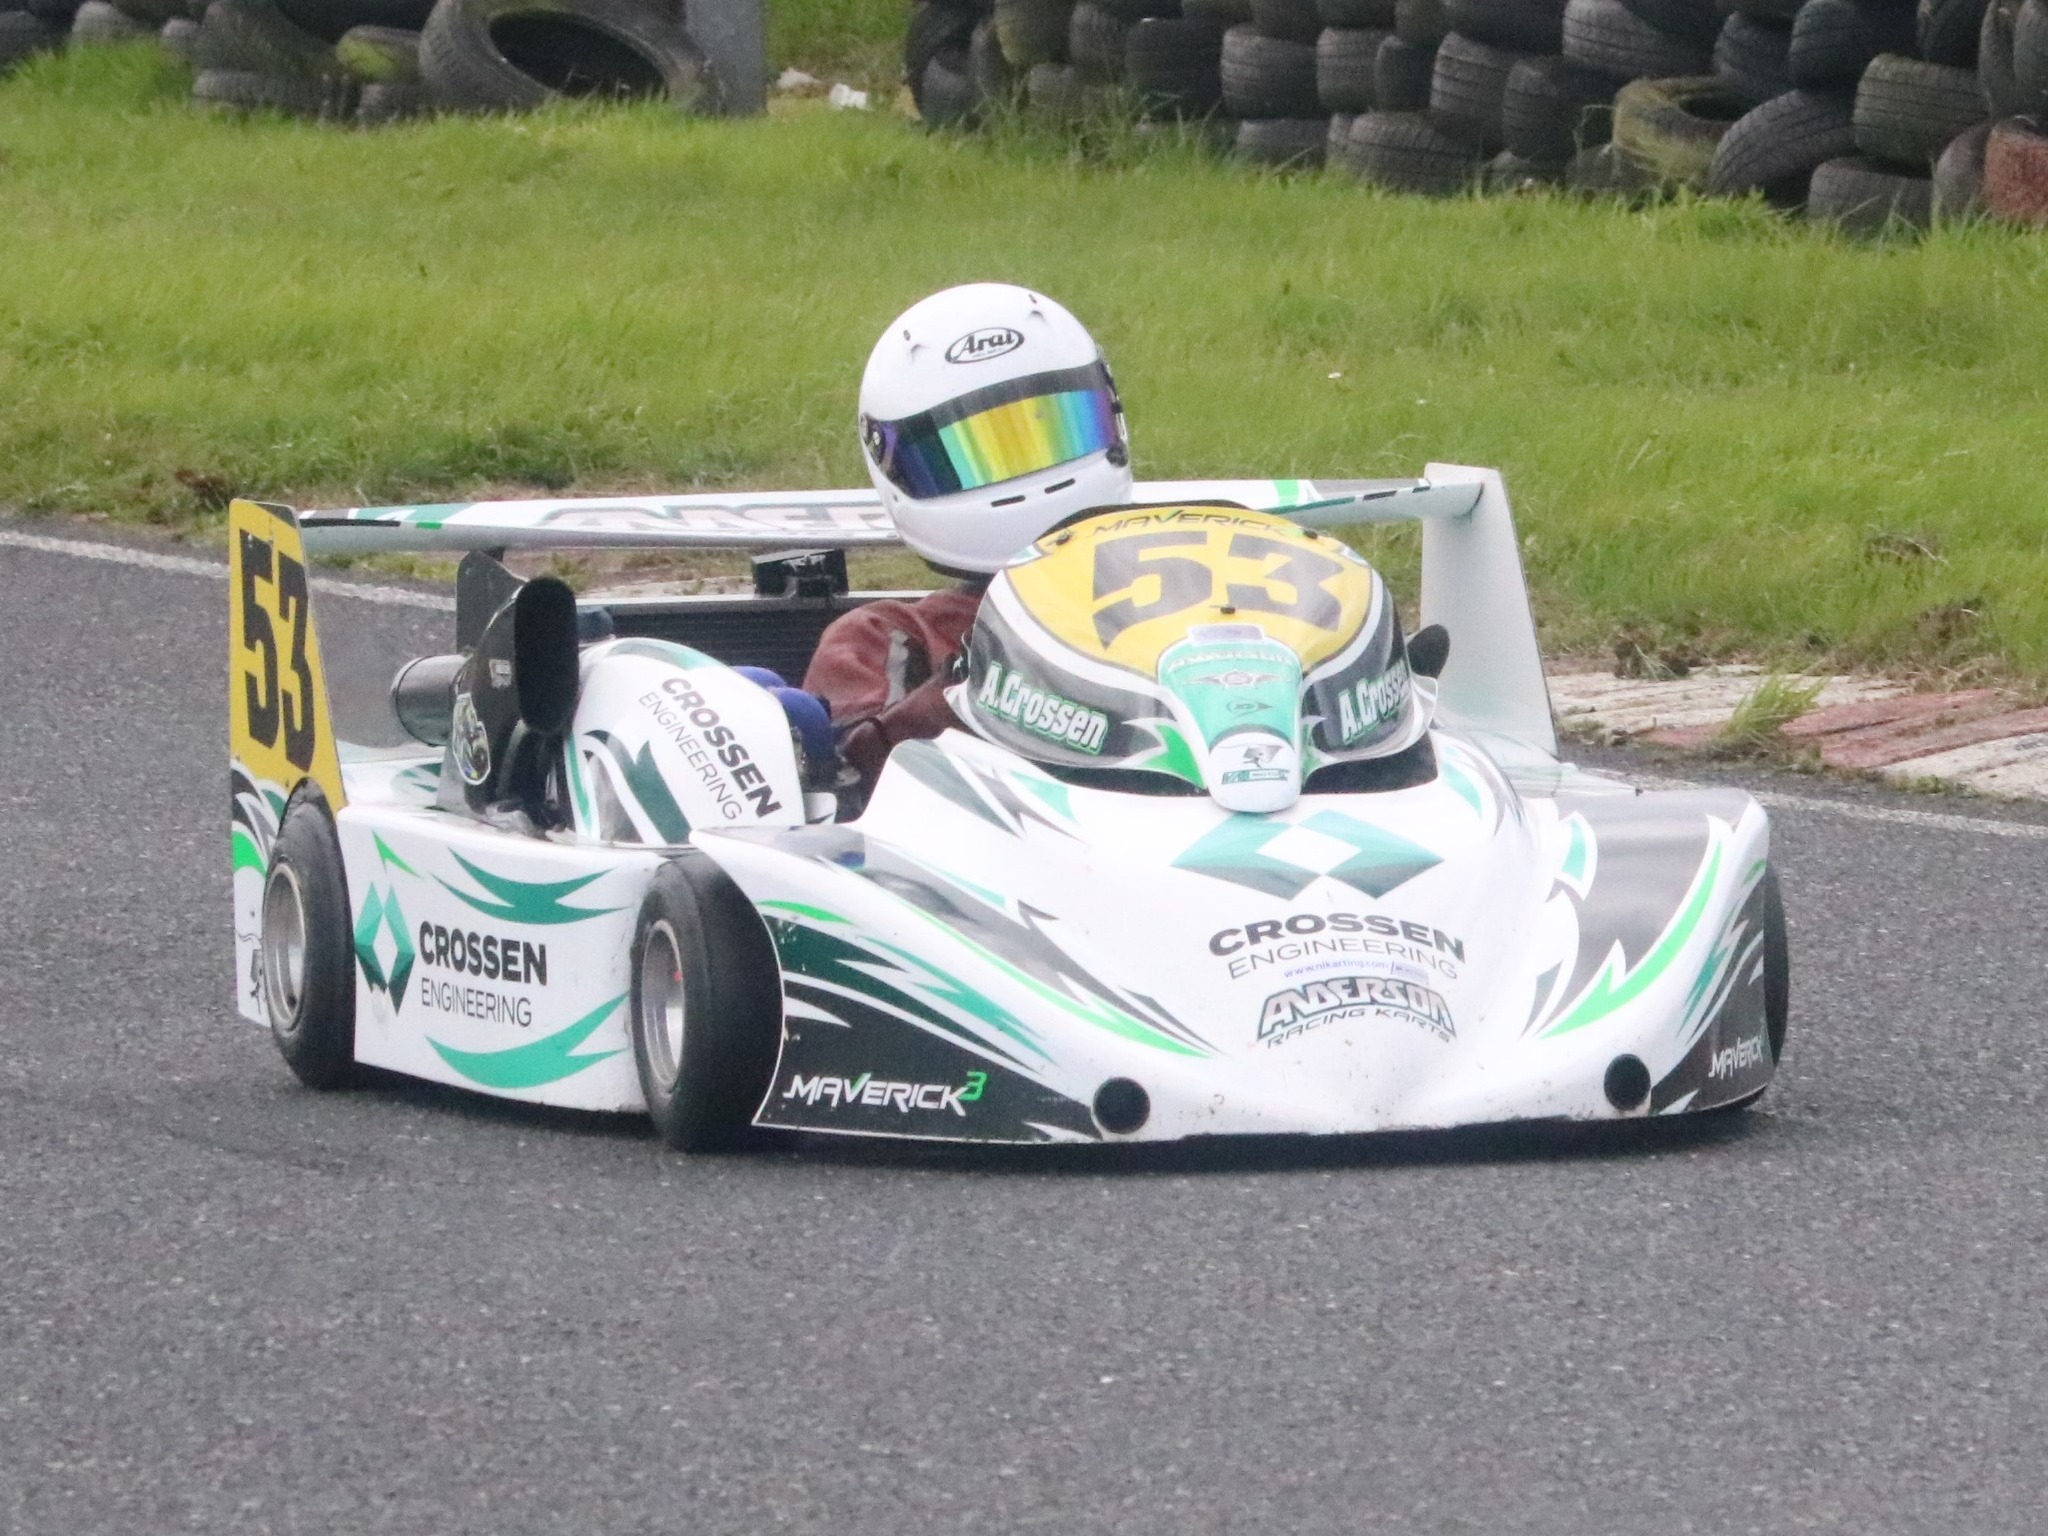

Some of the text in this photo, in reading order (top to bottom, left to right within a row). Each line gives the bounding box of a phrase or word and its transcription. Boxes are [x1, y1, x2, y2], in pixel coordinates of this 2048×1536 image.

[952, 328, 1016, 361] Arai
[1092, 529, 1344, 650] 53
[239, 527, 315, 773] 53
[638, 691, 743, 821] ENGINEERING
[661, 678, 783, 818] CROSSEN
[419, 920, 548, 986] CROSSEN
[1208, 912, 1465, 963] CROSSEN
[1227, 937, 1458, 980] ENGINEERING
[421, 977, 532, 1028] ENGINEERING
[1267, 1008, 1451, 1049] RACING KARTS
